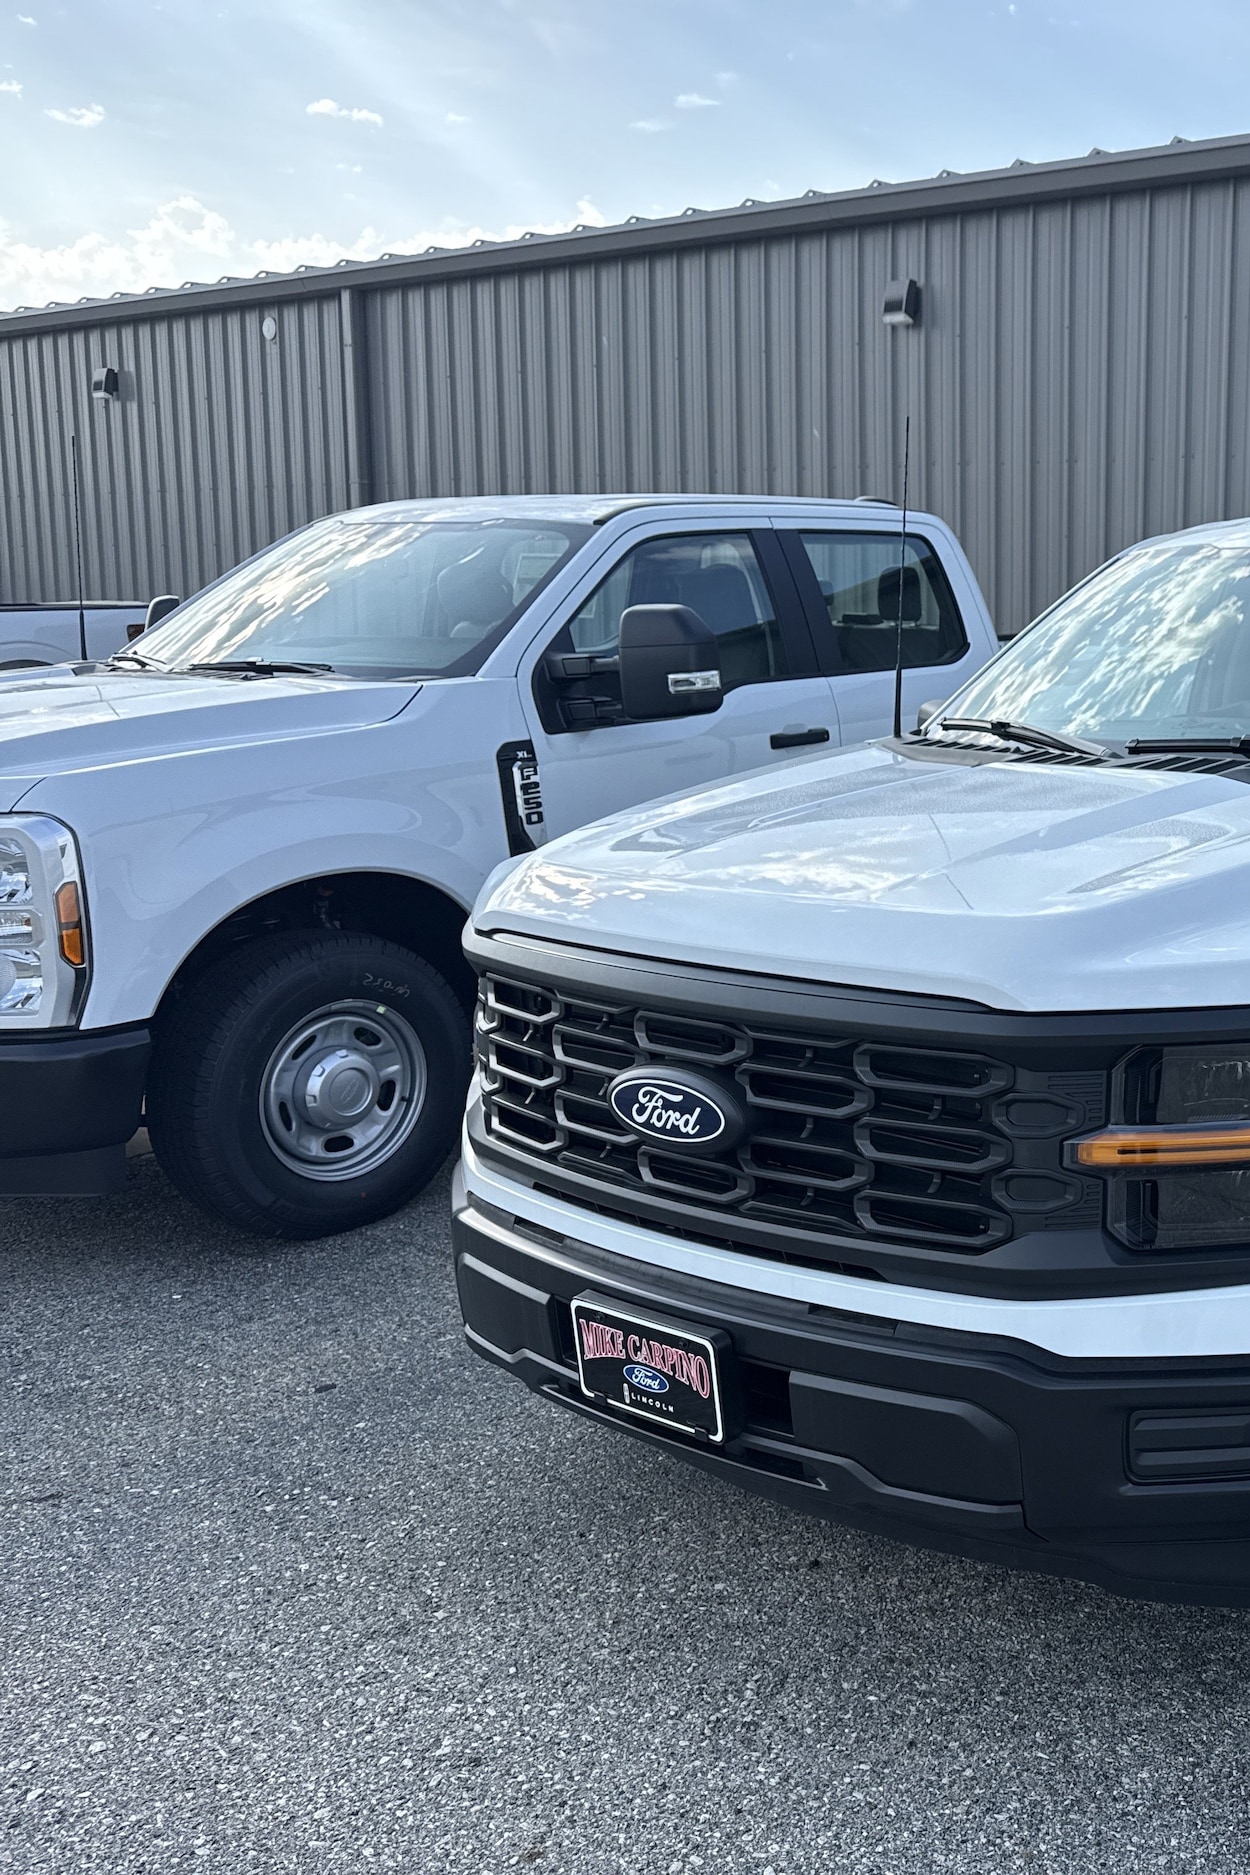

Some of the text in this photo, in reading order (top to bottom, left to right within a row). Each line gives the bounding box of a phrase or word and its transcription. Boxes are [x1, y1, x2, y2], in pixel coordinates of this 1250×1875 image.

[516, 750, 533, 759] XL
[631, 1086, 702, 1135] Ford
[579, 1319, 711, 1399] MIKE CARPINO
[631, 1367, 660, 1390] Ford
[631, 1392, 674, 1413] LINCOLN
